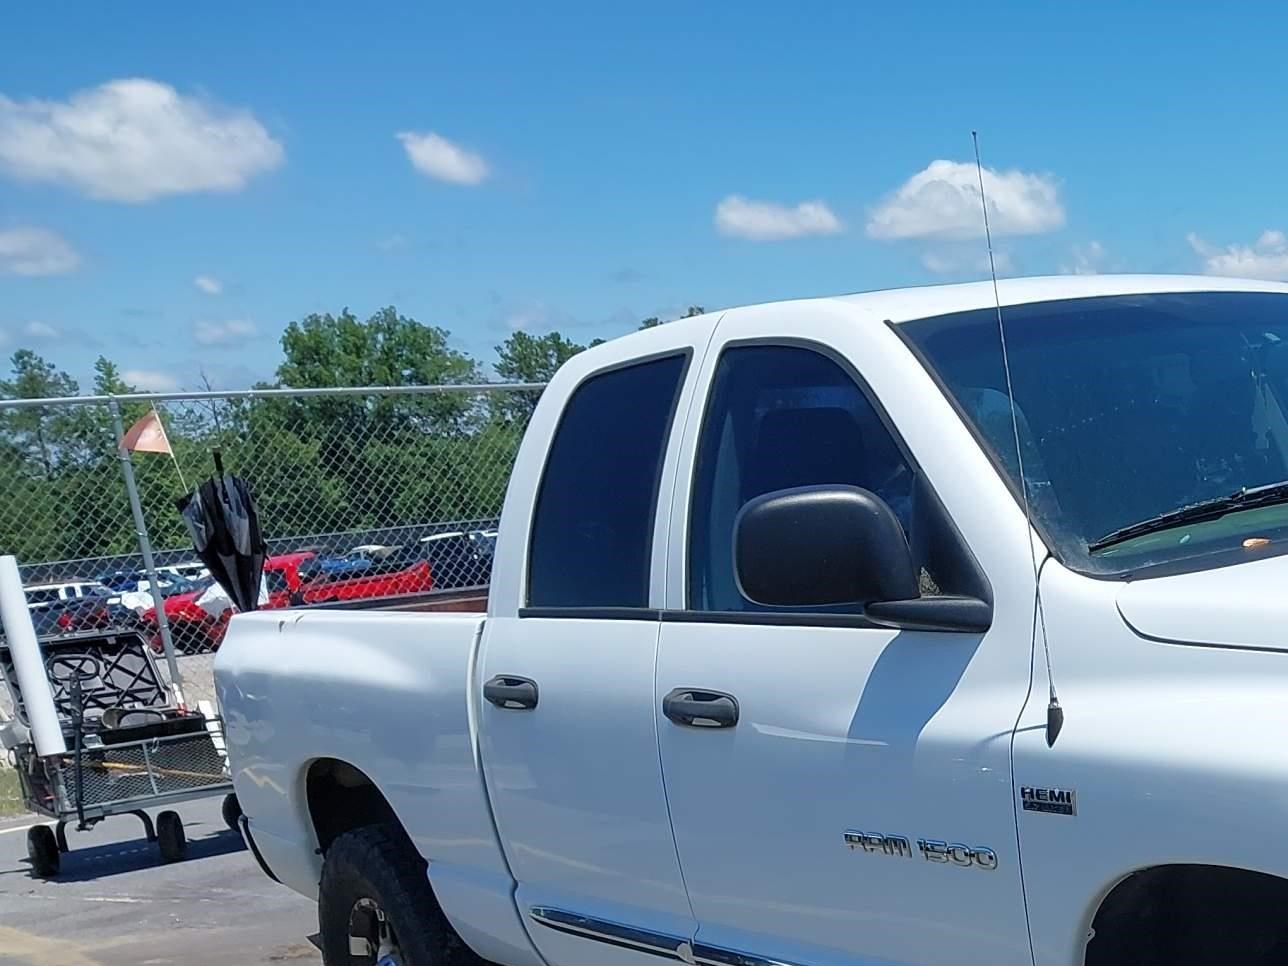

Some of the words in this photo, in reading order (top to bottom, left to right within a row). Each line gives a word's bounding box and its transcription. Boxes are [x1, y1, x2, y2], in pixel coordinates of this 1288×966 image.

[1021, 786, 1072, 803] HEMI
[843, 829, 913, 858] RAM
[916, 838, 999, 869] 1500
